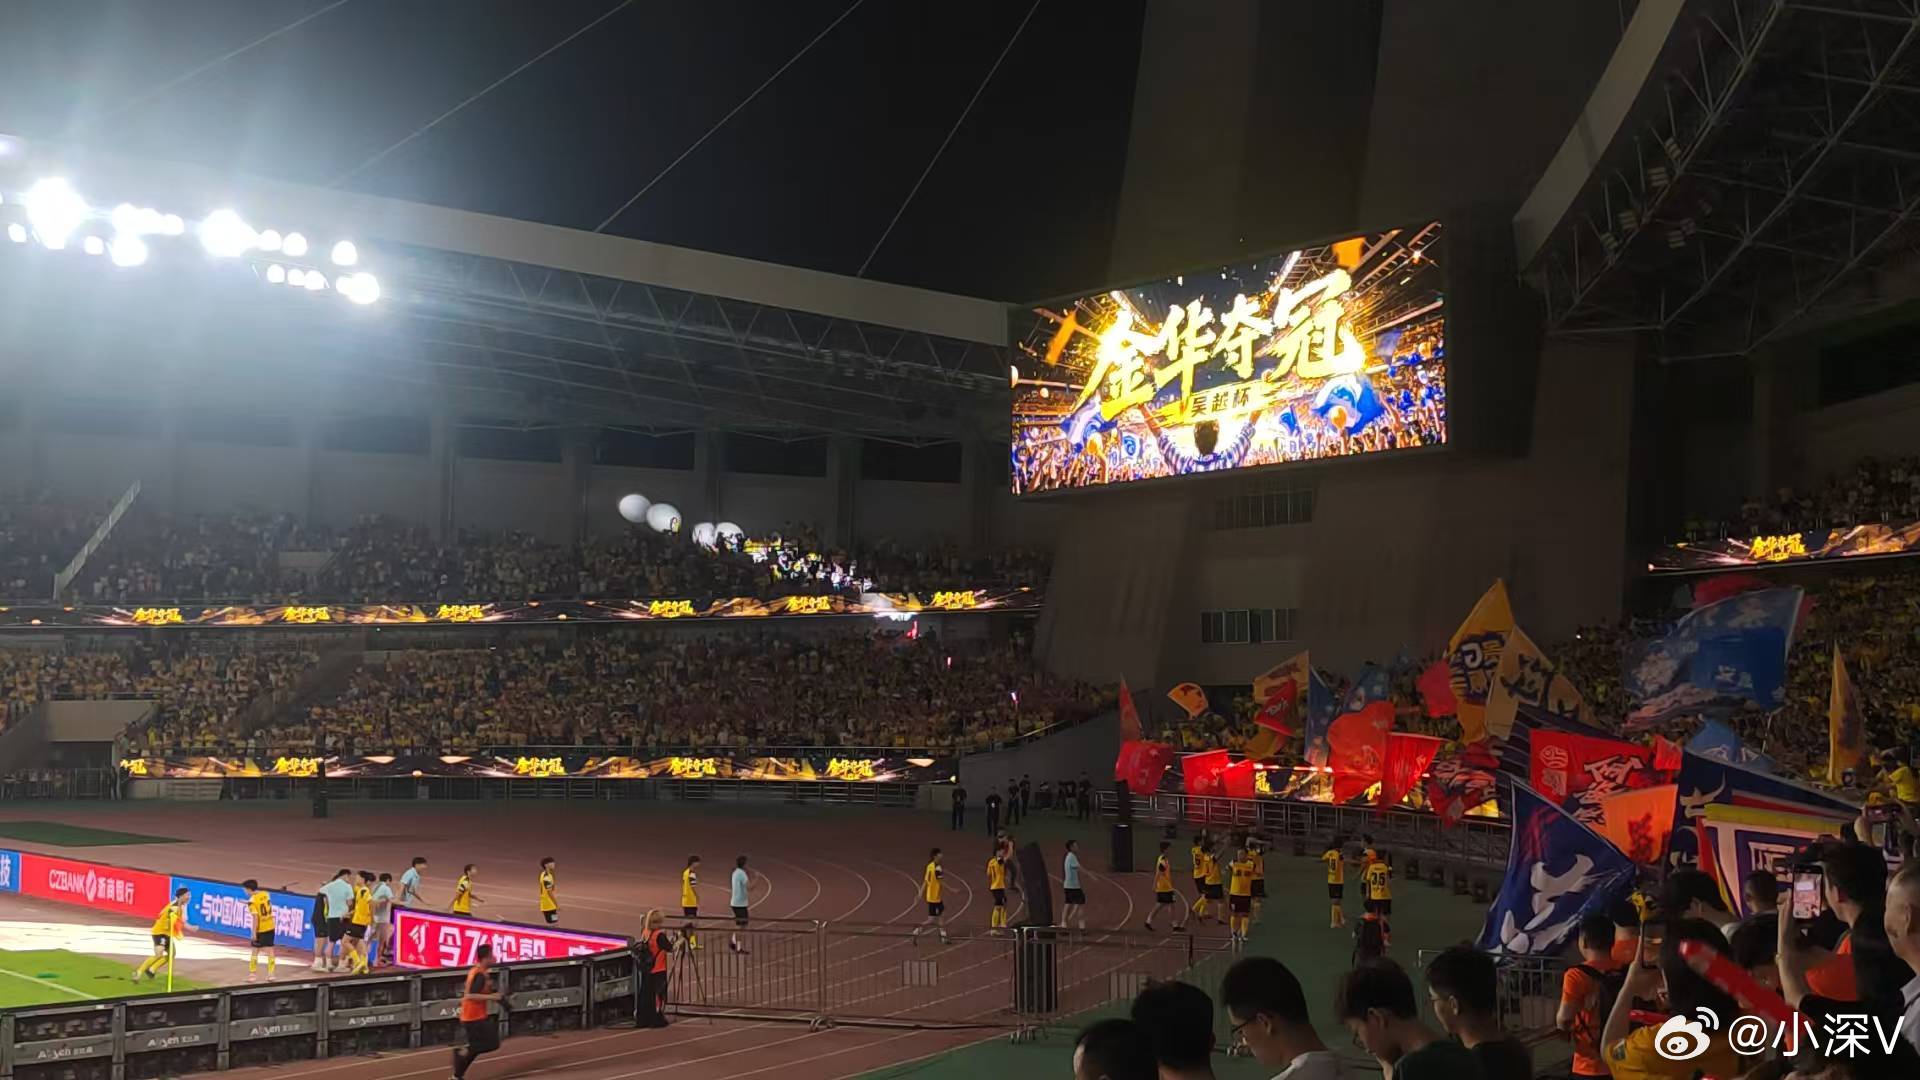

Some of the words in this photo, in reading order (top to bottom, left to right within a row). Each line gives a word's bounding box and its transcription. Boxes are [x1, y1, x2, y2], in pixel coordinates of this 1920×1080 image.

[1069, 268, 1366, 421] 金华夺冠
[1190, 386, 1252, 418] 吴越杯
[1749, 533, 1805, 558] 金华夺冠
[648, 599, 693, 615] 金华夺冠
[787, 595, 829, 611] 金华夺冠
[930, 591, 974, 607] 金华夺冠
[134, 606, 182, 621] 金华夺冠
[283, 605, 330, 620] 金华夺冠
[437, 603, 484, 619] 金华夺冠
[514, 757, 566, 775] 金华夺冠
[668, 757, 717, 775] 金华夺冠
[826, 757, 874, 776] 金华夺冠
[49, 868, 86, 896] CZBANK
[97, 876, 135, 905] 浙商银行
